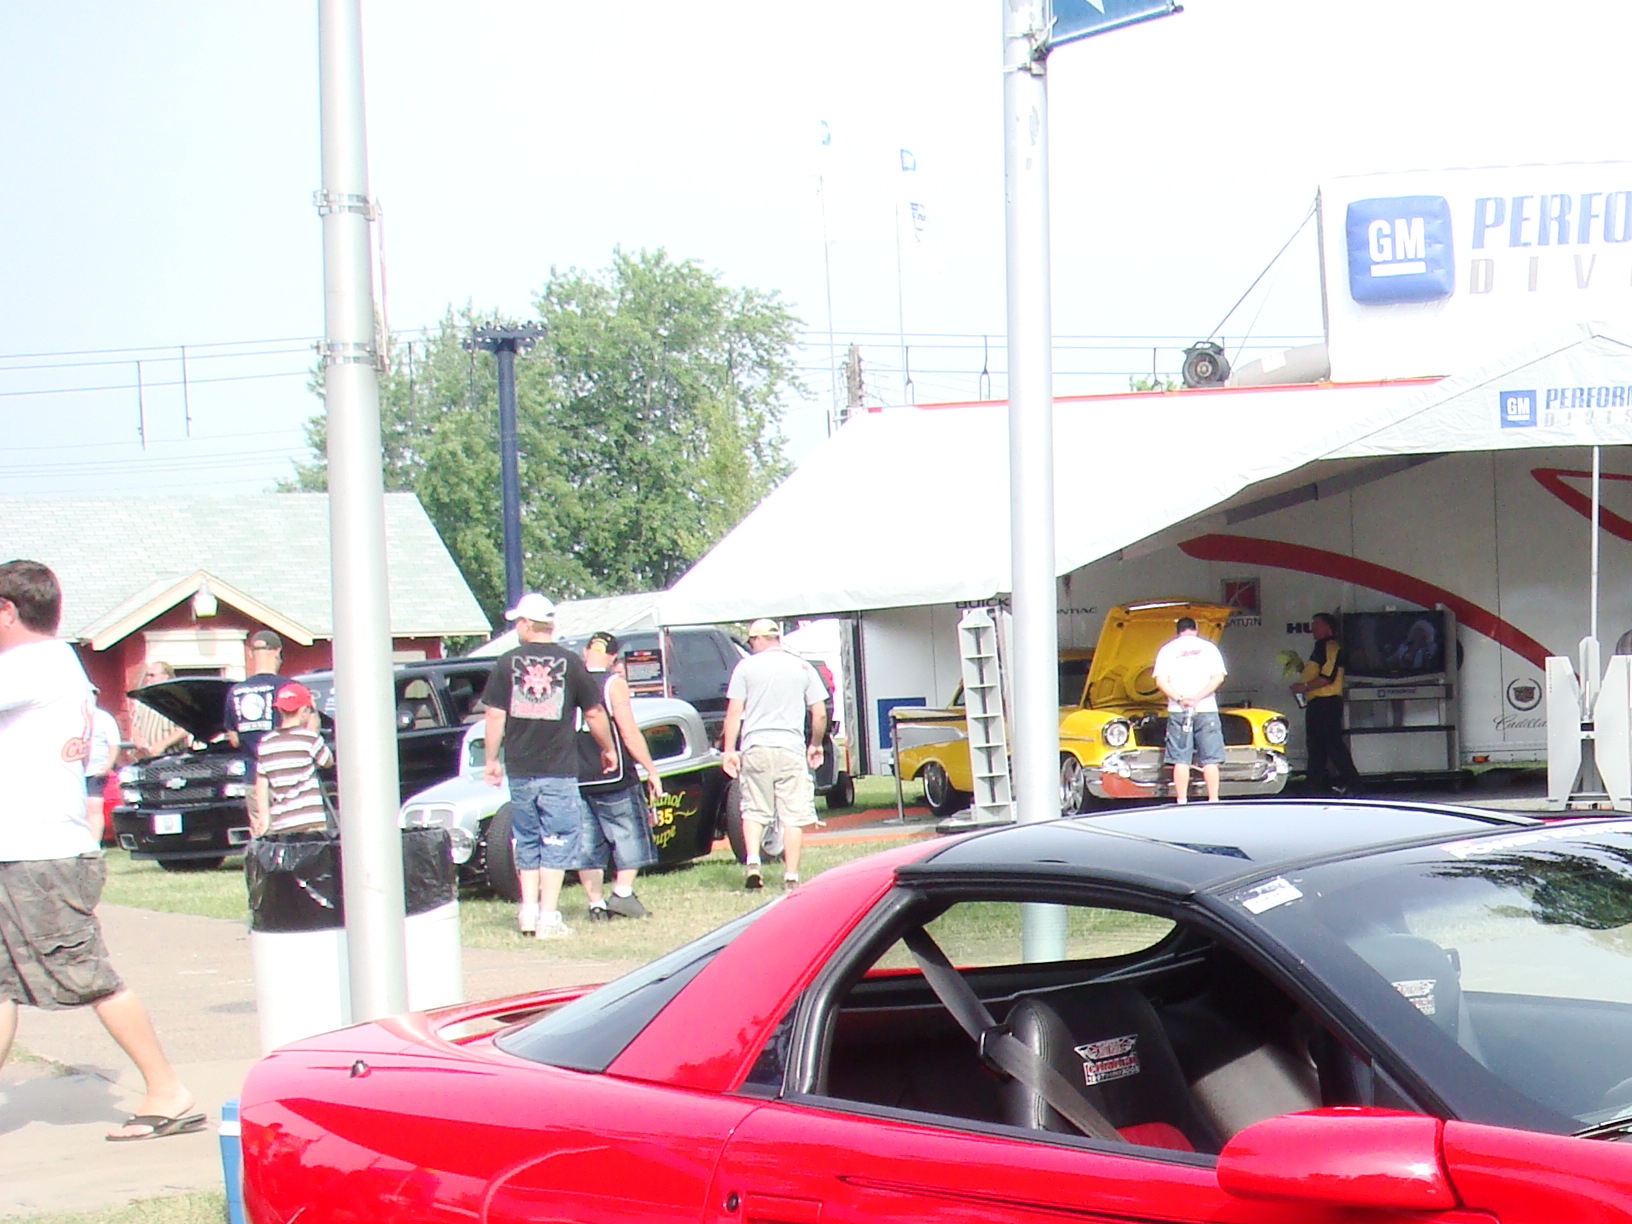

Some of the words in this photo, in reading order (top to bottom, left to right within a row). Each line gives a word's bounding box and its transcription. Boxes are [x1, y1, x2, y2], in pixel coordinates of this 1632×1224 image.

[1368, 216, 1426, 262] GM
[1507, 397, 1531, 415] GM
[1493, 713, 1547, 731] Cadilla
